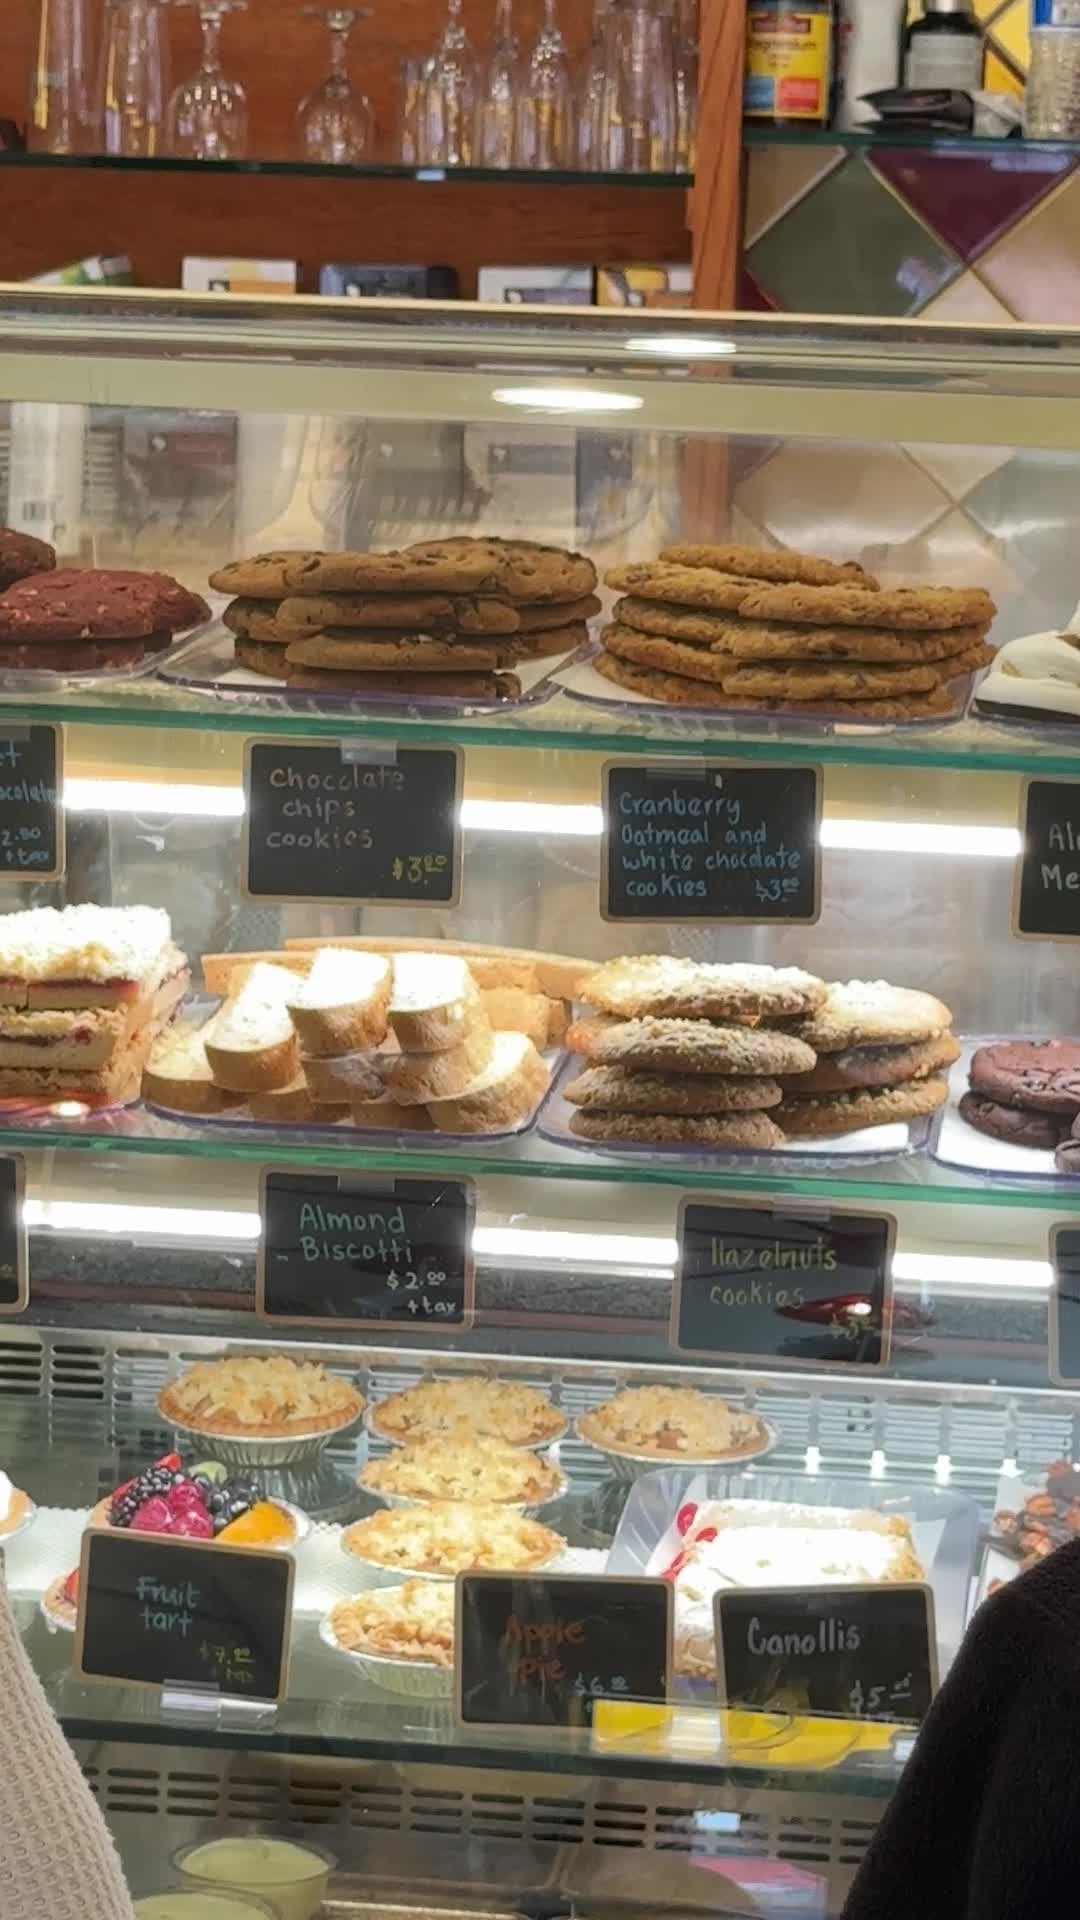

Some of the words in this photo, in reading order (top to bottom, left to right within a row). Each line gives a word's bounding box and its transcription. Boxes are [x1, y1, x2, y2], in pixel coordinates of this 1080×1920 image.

[269, 765, 405, 790] Chocolate
[282, 797, 356, 824] chips
[619, 789, 740, 825] Cranberry
[266, 827, 374, 849] cookies
[622, 820, 709, 846] Oatmeal
[725, 822, 767, 844] and
[1049, 820, 1080, 852] Al
[622, 849, 693, 871] white
[300, 1203, 406, 1233] Almond
[301, 1236, 413, 1264] Biscotti
[386, 1269, 446, 1291] $2.00
[136, 1576, 200, 1608] Fruit
[140, 1605, 193, 1637] tart
[503, 1615, 585, 1654] Apple
[748, 1617, 861, 1656] Canollis
